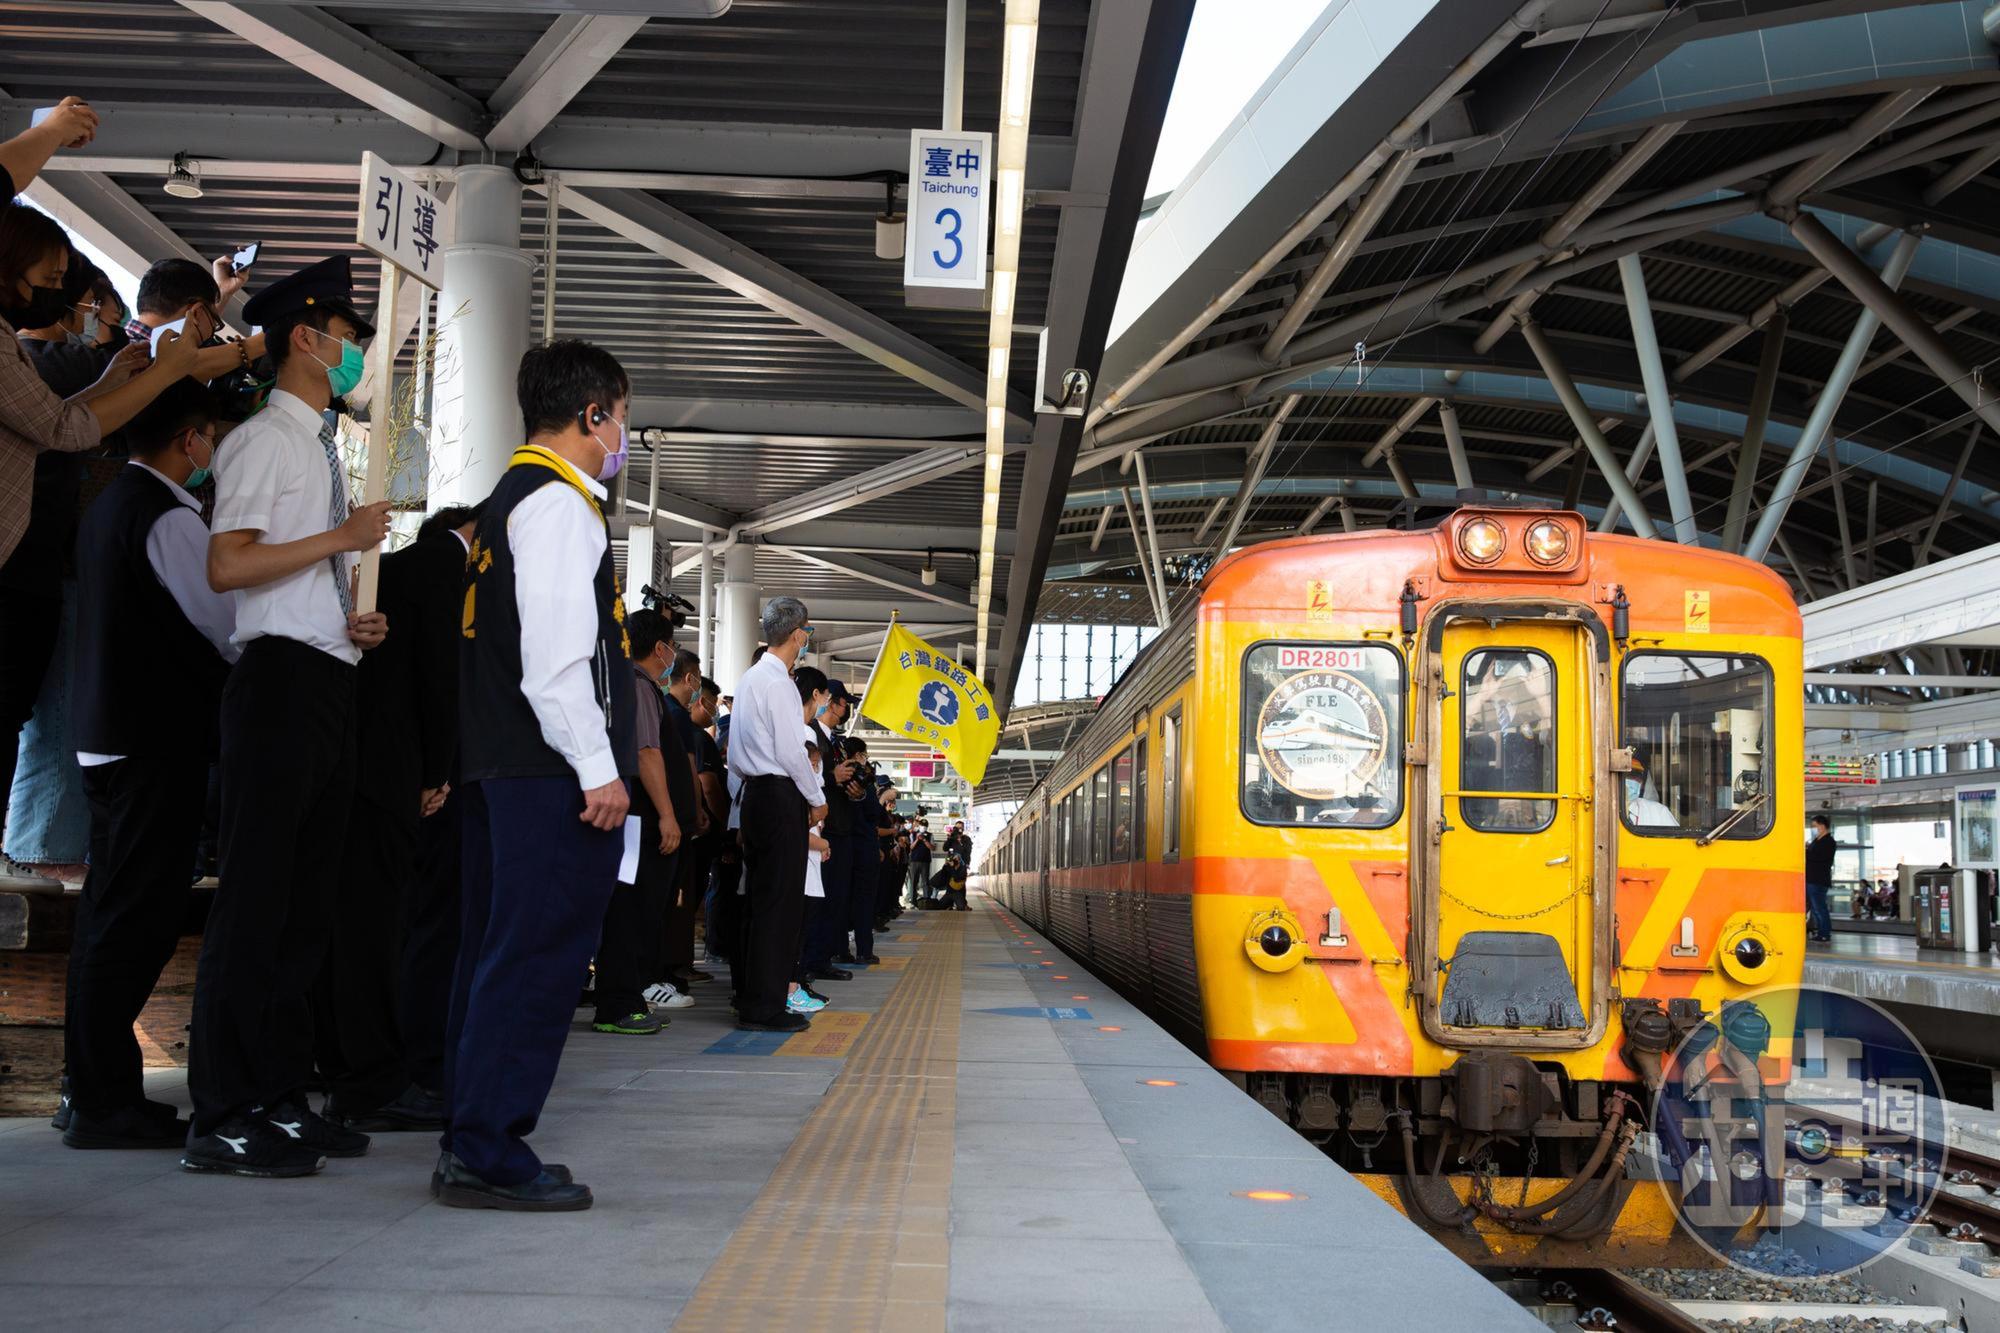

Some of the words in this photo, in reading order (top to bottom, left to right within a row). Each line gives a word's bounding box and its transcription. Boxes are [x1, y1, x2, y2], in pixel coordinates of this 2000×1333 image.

[925, 147, 979, 178] 臺中
[922, 181, 978, 197] Taichung
[376, 176, 439, 272] 引導
[933, 208, 962, 269] 3
[1282, 650, 1360, 668] DR2801
[899, 649, 990, 721] 台灣鐵路工會
[1305, 695, 1338, 707] FLE
[1297, 754, 1325, 764] since
[1863, 757, 1877, 766] 2A
